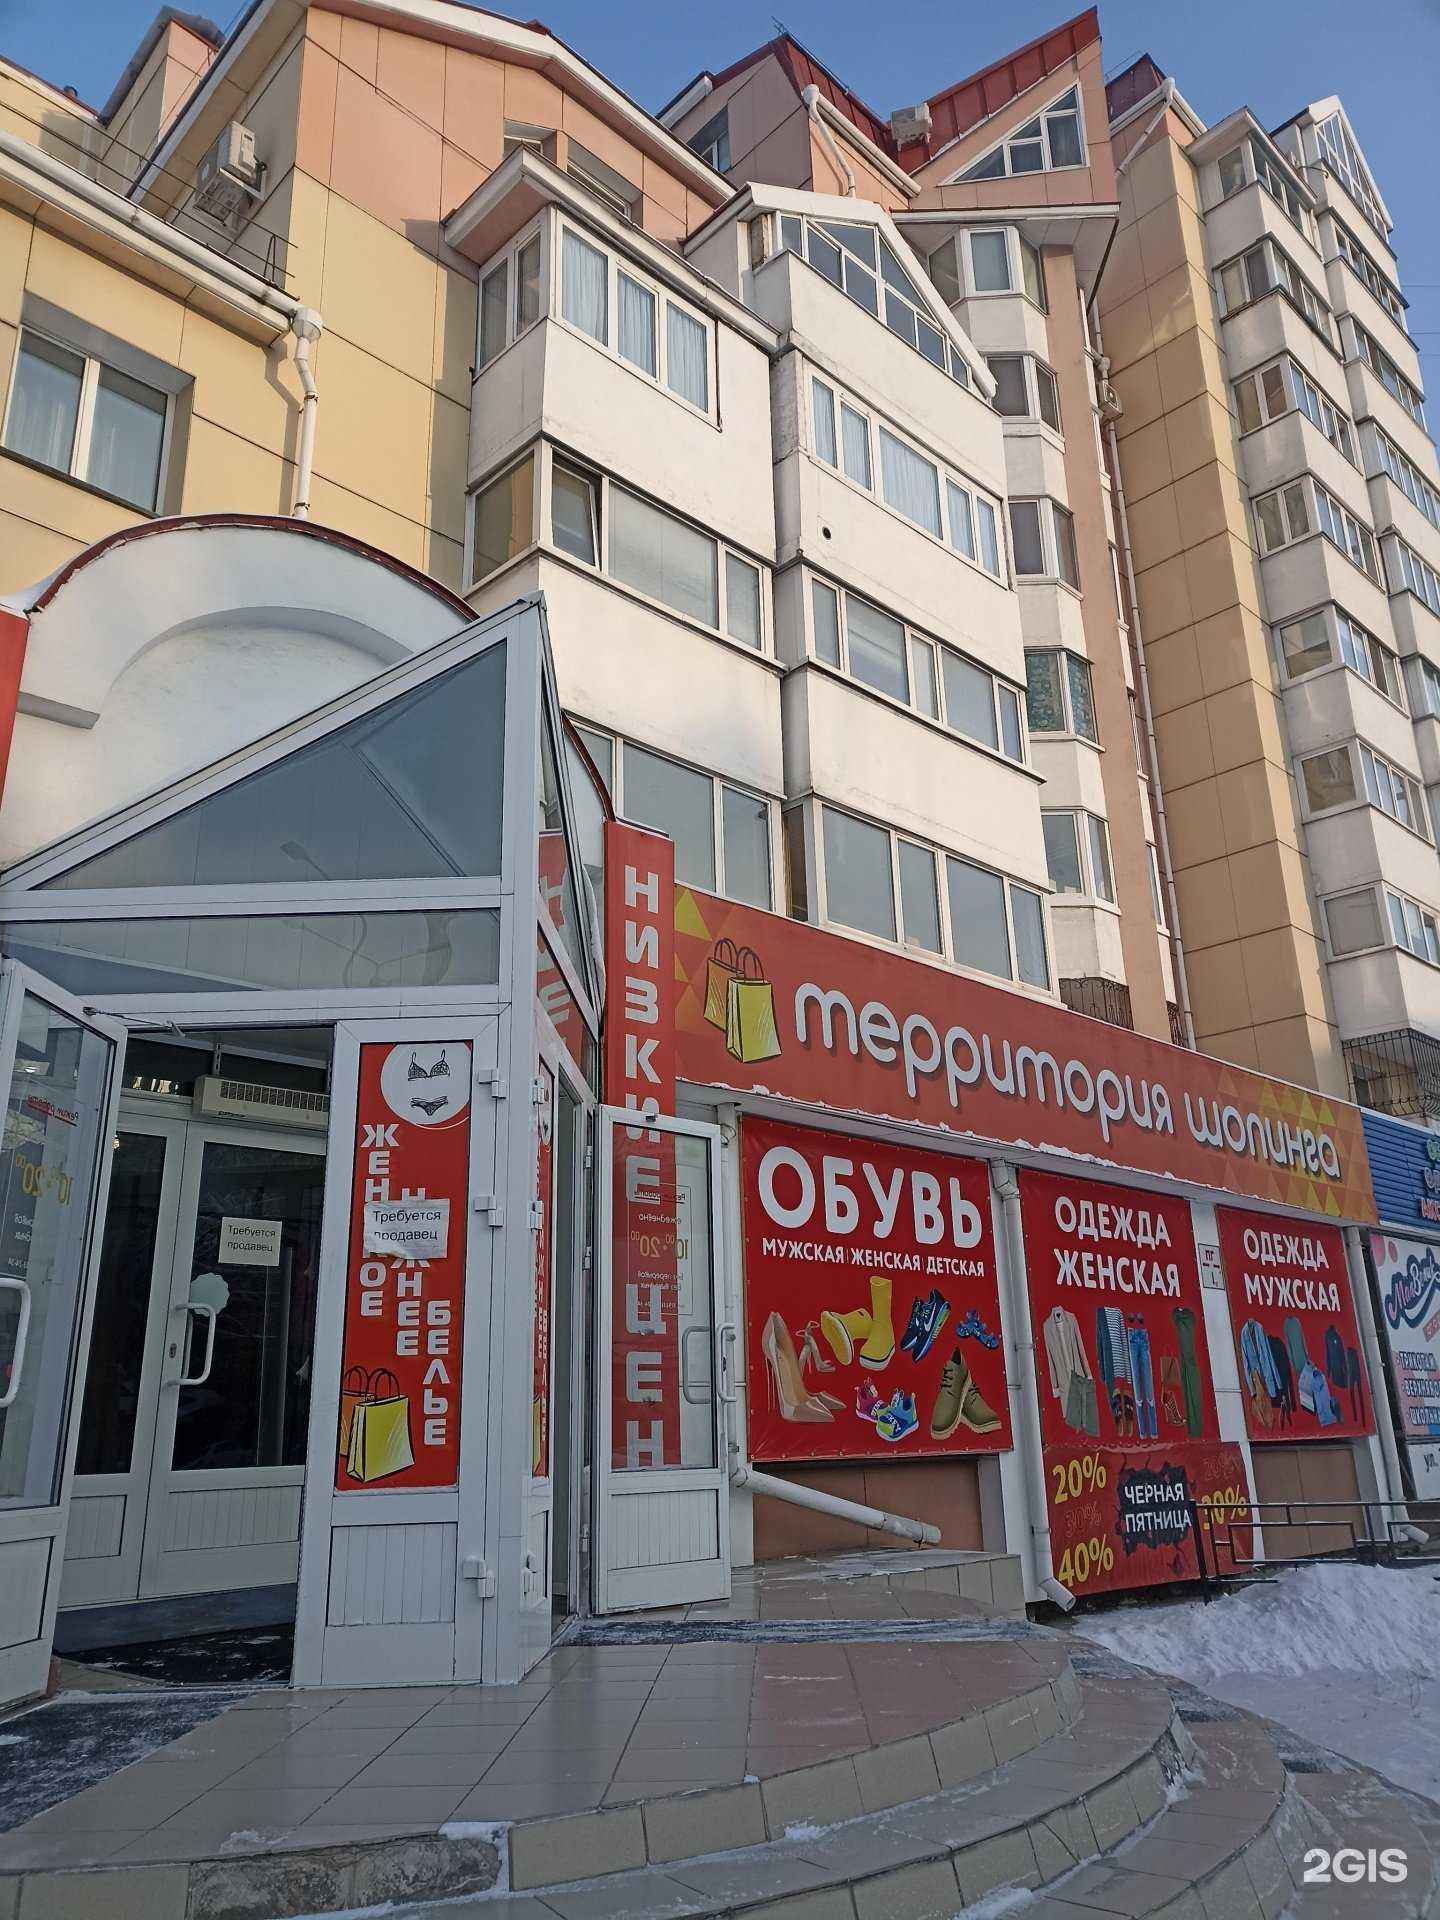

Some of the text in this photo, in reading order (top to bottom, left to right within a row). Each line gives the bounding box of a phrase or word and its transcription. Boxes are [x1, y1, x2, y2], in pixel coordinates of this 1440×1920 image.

[795, 982, 1342, 1179] территория шопинга
[361, 1124, 400, 1316] ЖЕНОЕ
[373, 1208, 441, 1225] Требуется
[758, 1146, 982, 1249] ОБУВЬ
[1054, 1195, 1172, 1250] ОДЕЖДА
[227, 1241, 273, 1252] продавец
[228, 1225, 276, 1237] Требуется
[1243, 1228, 1330, 1272] ОДЕЖДА
[391, 1187, 427, 1356] ННЕЕ
[762, 1237, 985, 1277] МУЖСКАЯ ЖЕНСКАЯ ДЕТСКАЯ
[1053, 1248, 1181, 1298] ЖЕНСКАЯ
[1244, 1273, 1341, 1312] МУЖСКАЯ
[422, 1300, 451, 1446] БЕЛЬЕ
[1052, 1452, 1107, 1505] 20%
[1124, 1482, 1185, 1505] ЧЕРНАЯ
[1125, 1508, 1192, 1534] ПЯТНИЦА
[1058, 1533, 1114, 1587] 40%
